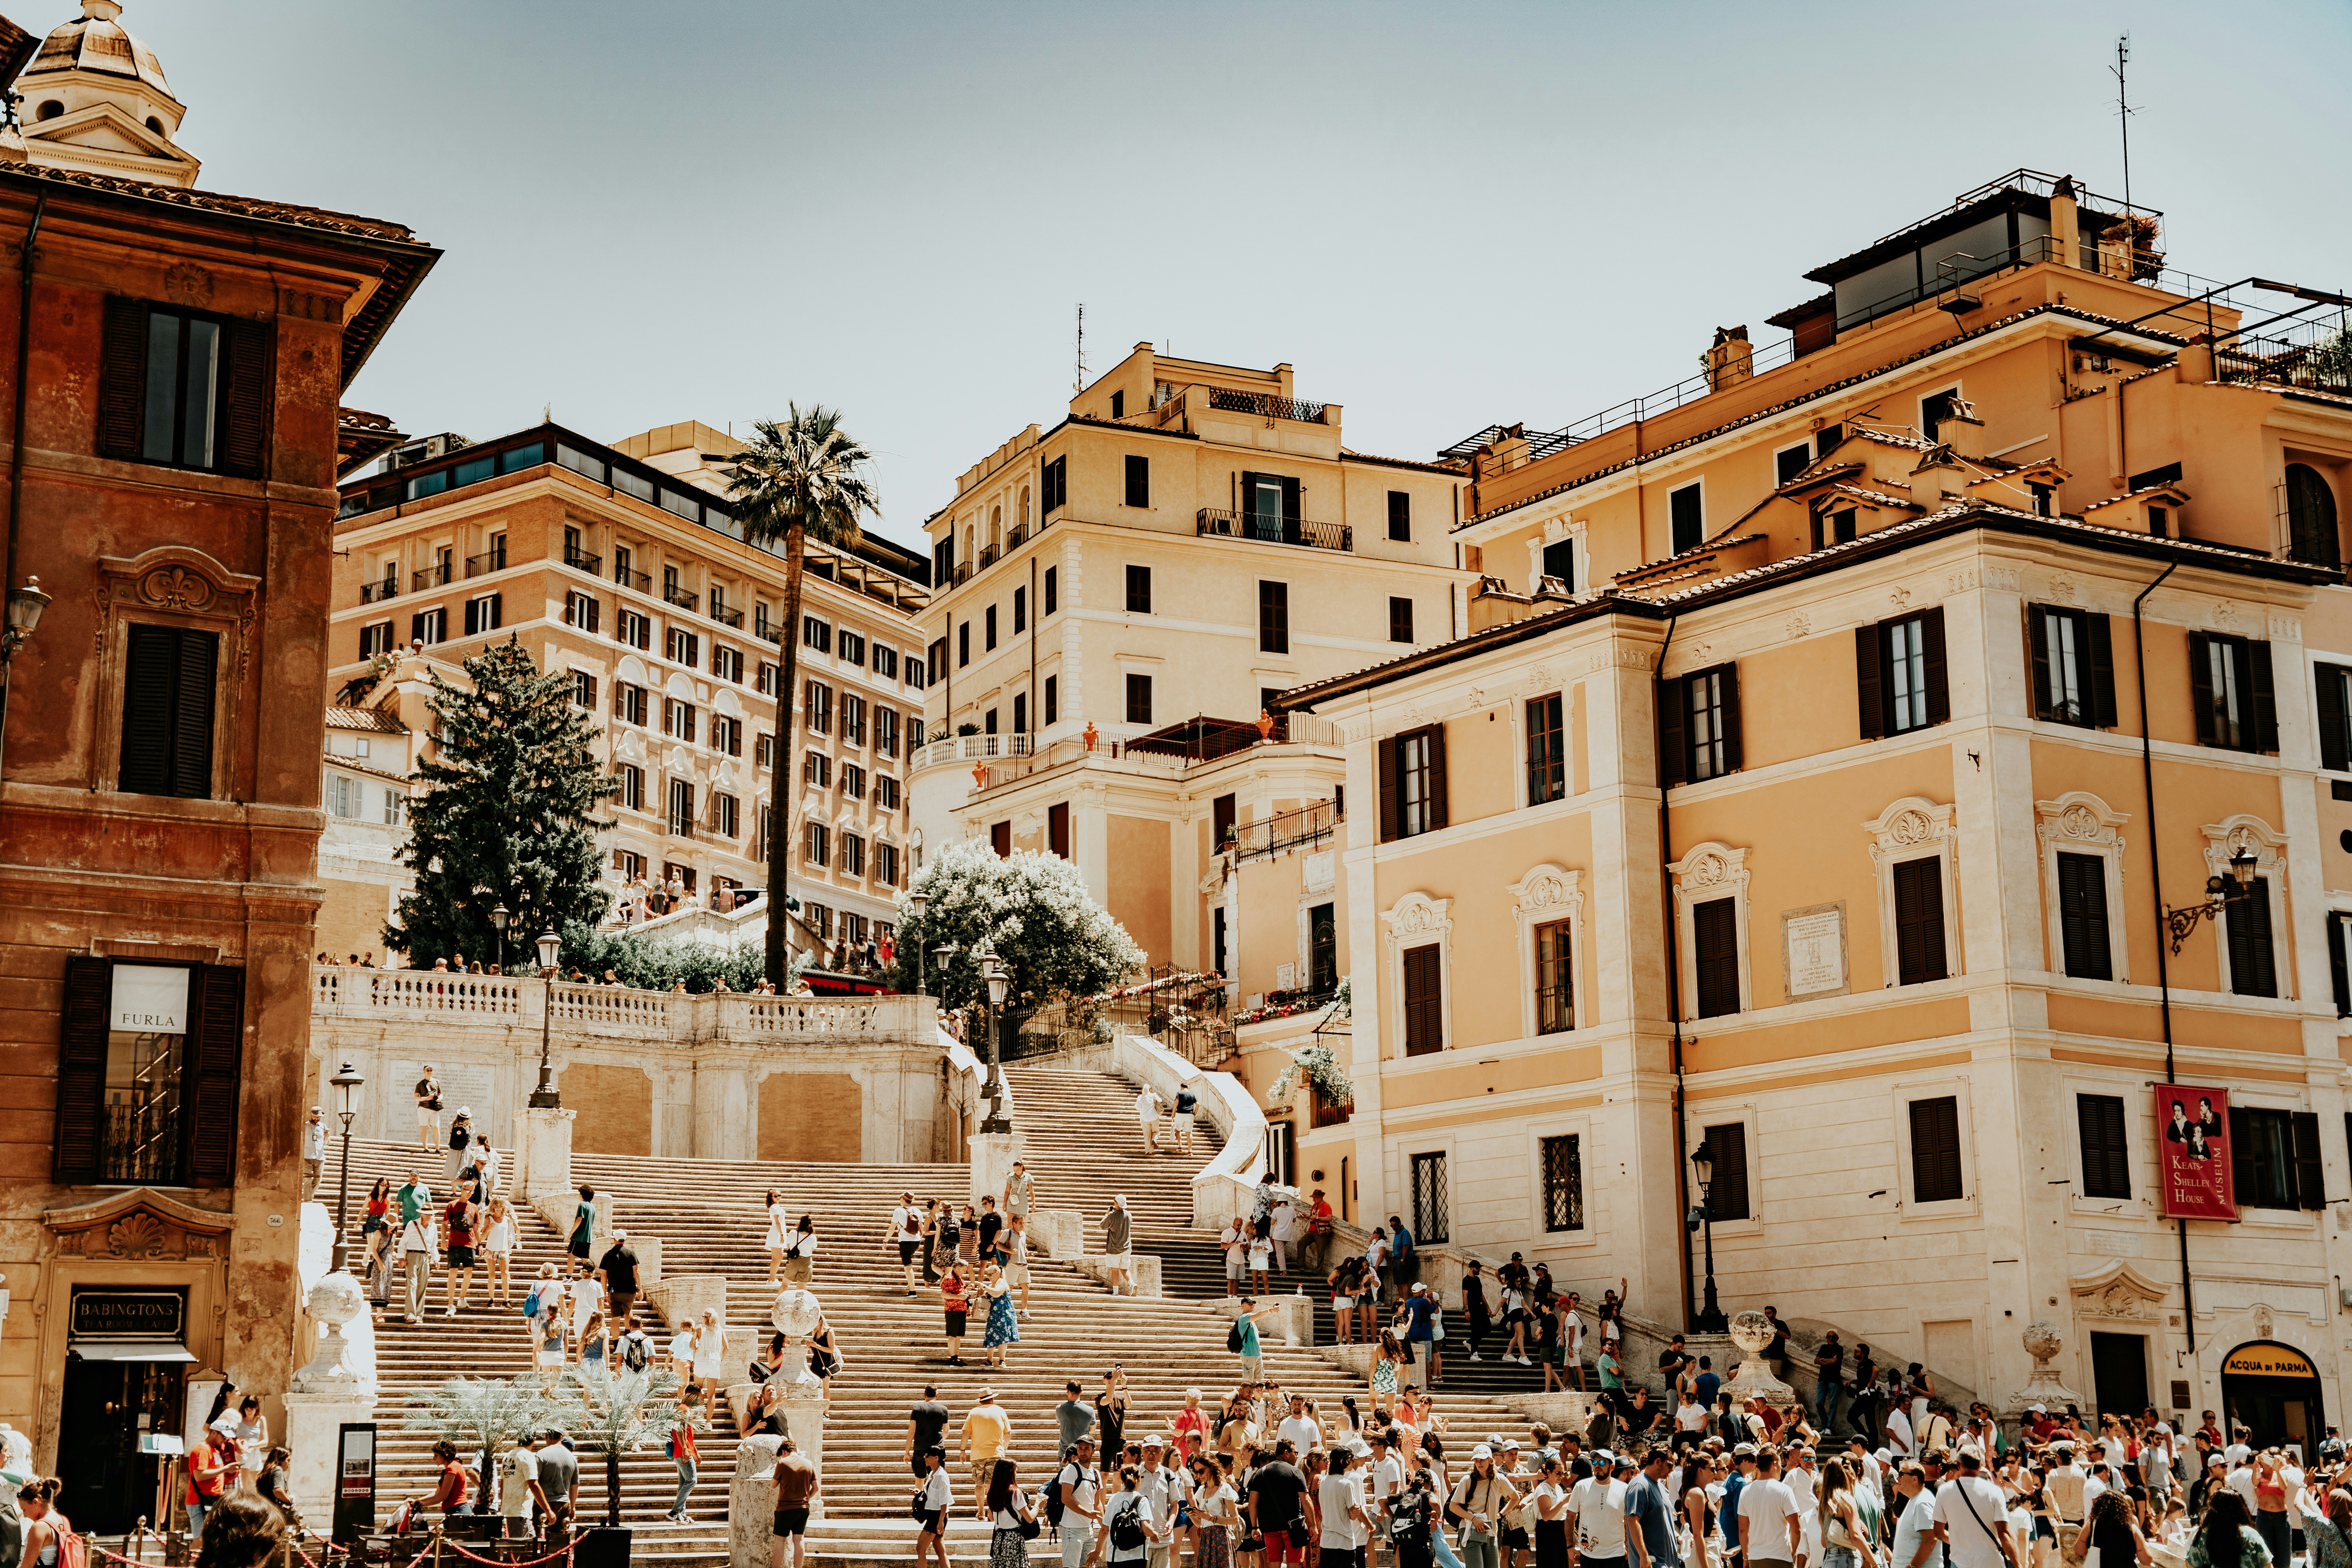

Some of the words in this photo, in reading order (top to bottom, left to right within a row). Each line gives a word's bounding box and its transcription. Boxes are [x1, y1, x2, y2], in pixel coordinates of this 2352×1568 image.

[122, 1013, 174, 1026] FURLA
[2172, 1155, 2203, 1170] KEATS-
[2174, 1172, 2210, 1187] SHELLEY
[2214, 1148, 2226, 1205] MUSEUM
[2175, 1189, 2205, 1203] HOUSE
[243, 1240, 258, 1251] 25
[81, 1304, 172, 1315] BABINGTONS
[106, 1320, 132, 1328] ROOM
[2230, 1360, 2263, 1371] ACQUA
[2275, 1362, 2308, 1372] PARMA
[1394, 1518, 1411, 1526] NIKE
